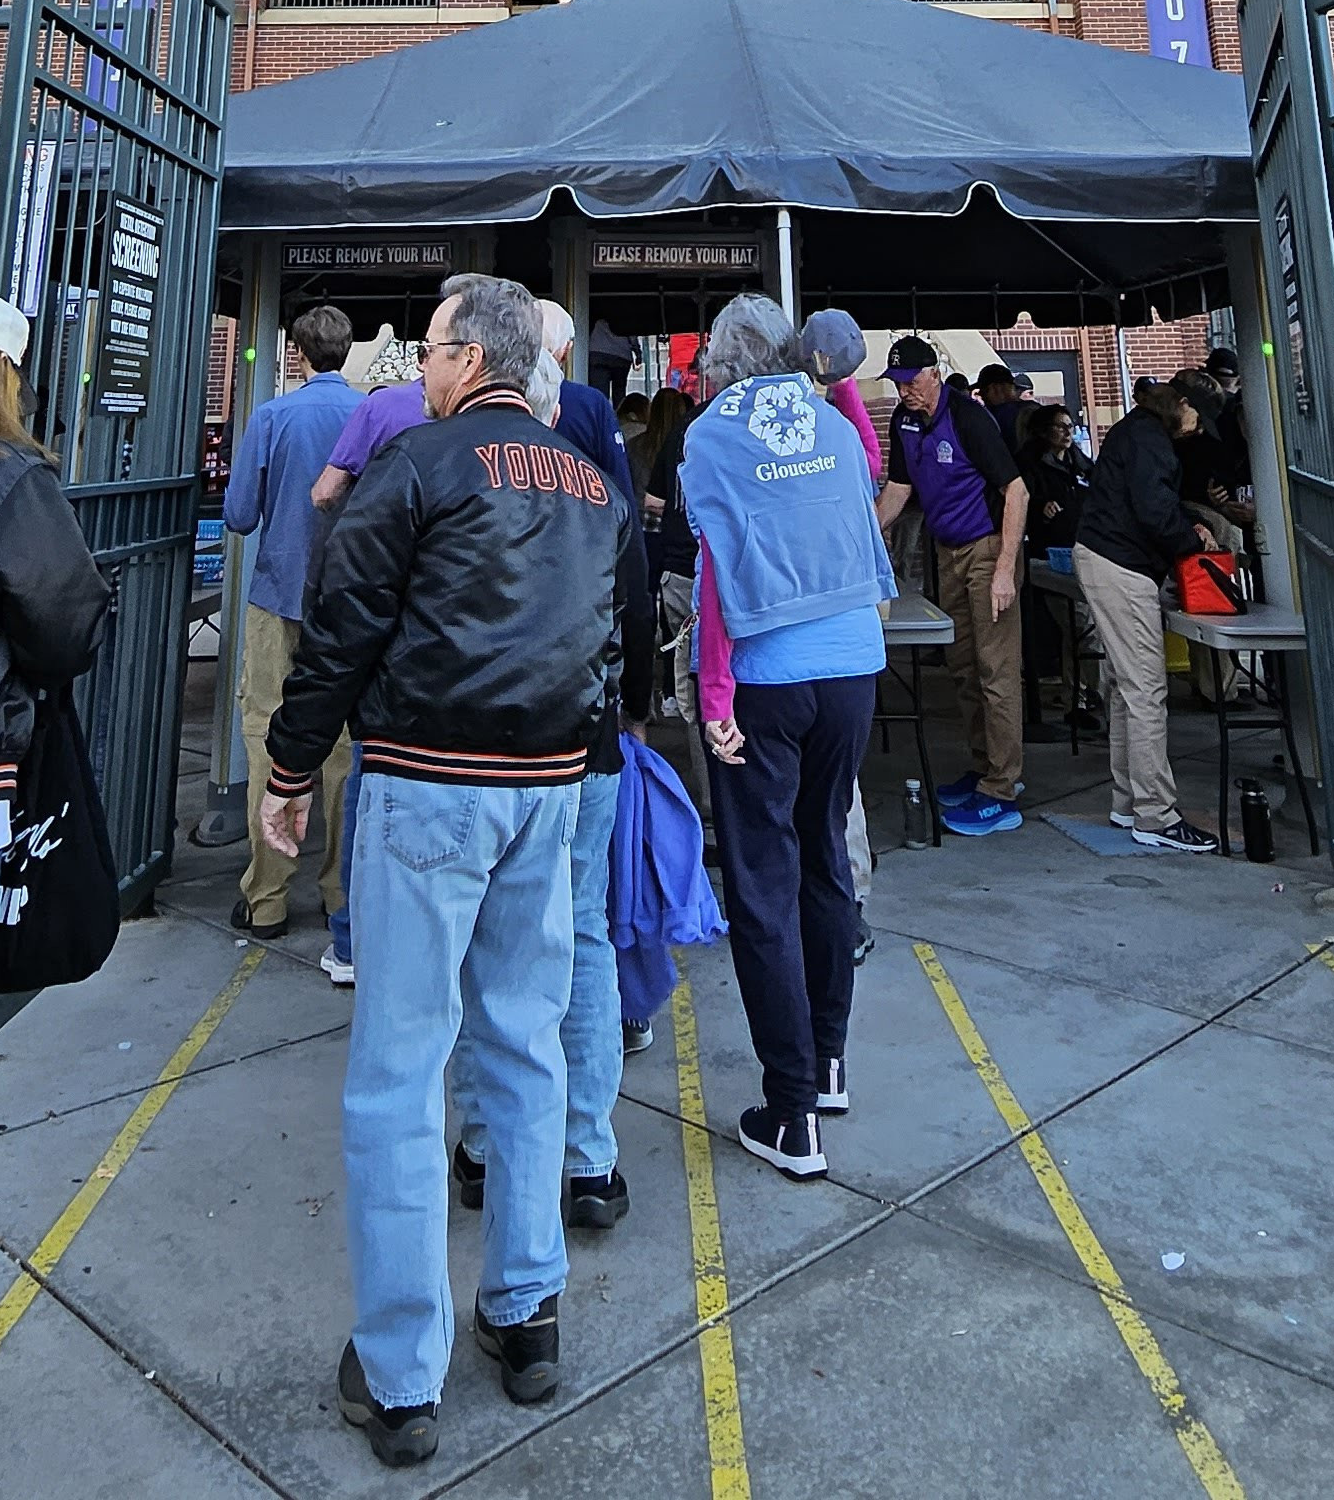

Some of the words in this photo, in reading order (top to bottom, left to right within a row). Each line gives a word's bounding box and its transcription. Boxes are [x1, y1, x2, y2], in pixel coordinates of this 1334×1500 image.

[111, 230, 160, 279] SCREENING
[288, 248, 332, 264] PLEASE
[335, 247, 384, 263] REMOVE
[387, 247, 418, 263] YOUR
[422, 246, 445, 263] HAT
[598, 246, 642, 263] PLEASE
[645, 247, 693, 263] REMOVE
[696, 247, 727, 264] YOUR
[730, 248, 753, 264] HAT
[474, 442, 609, 506] YOUNG
[755, 454, 837, 482] Gloucester
[978, 803, 1003, 820] HOKA
